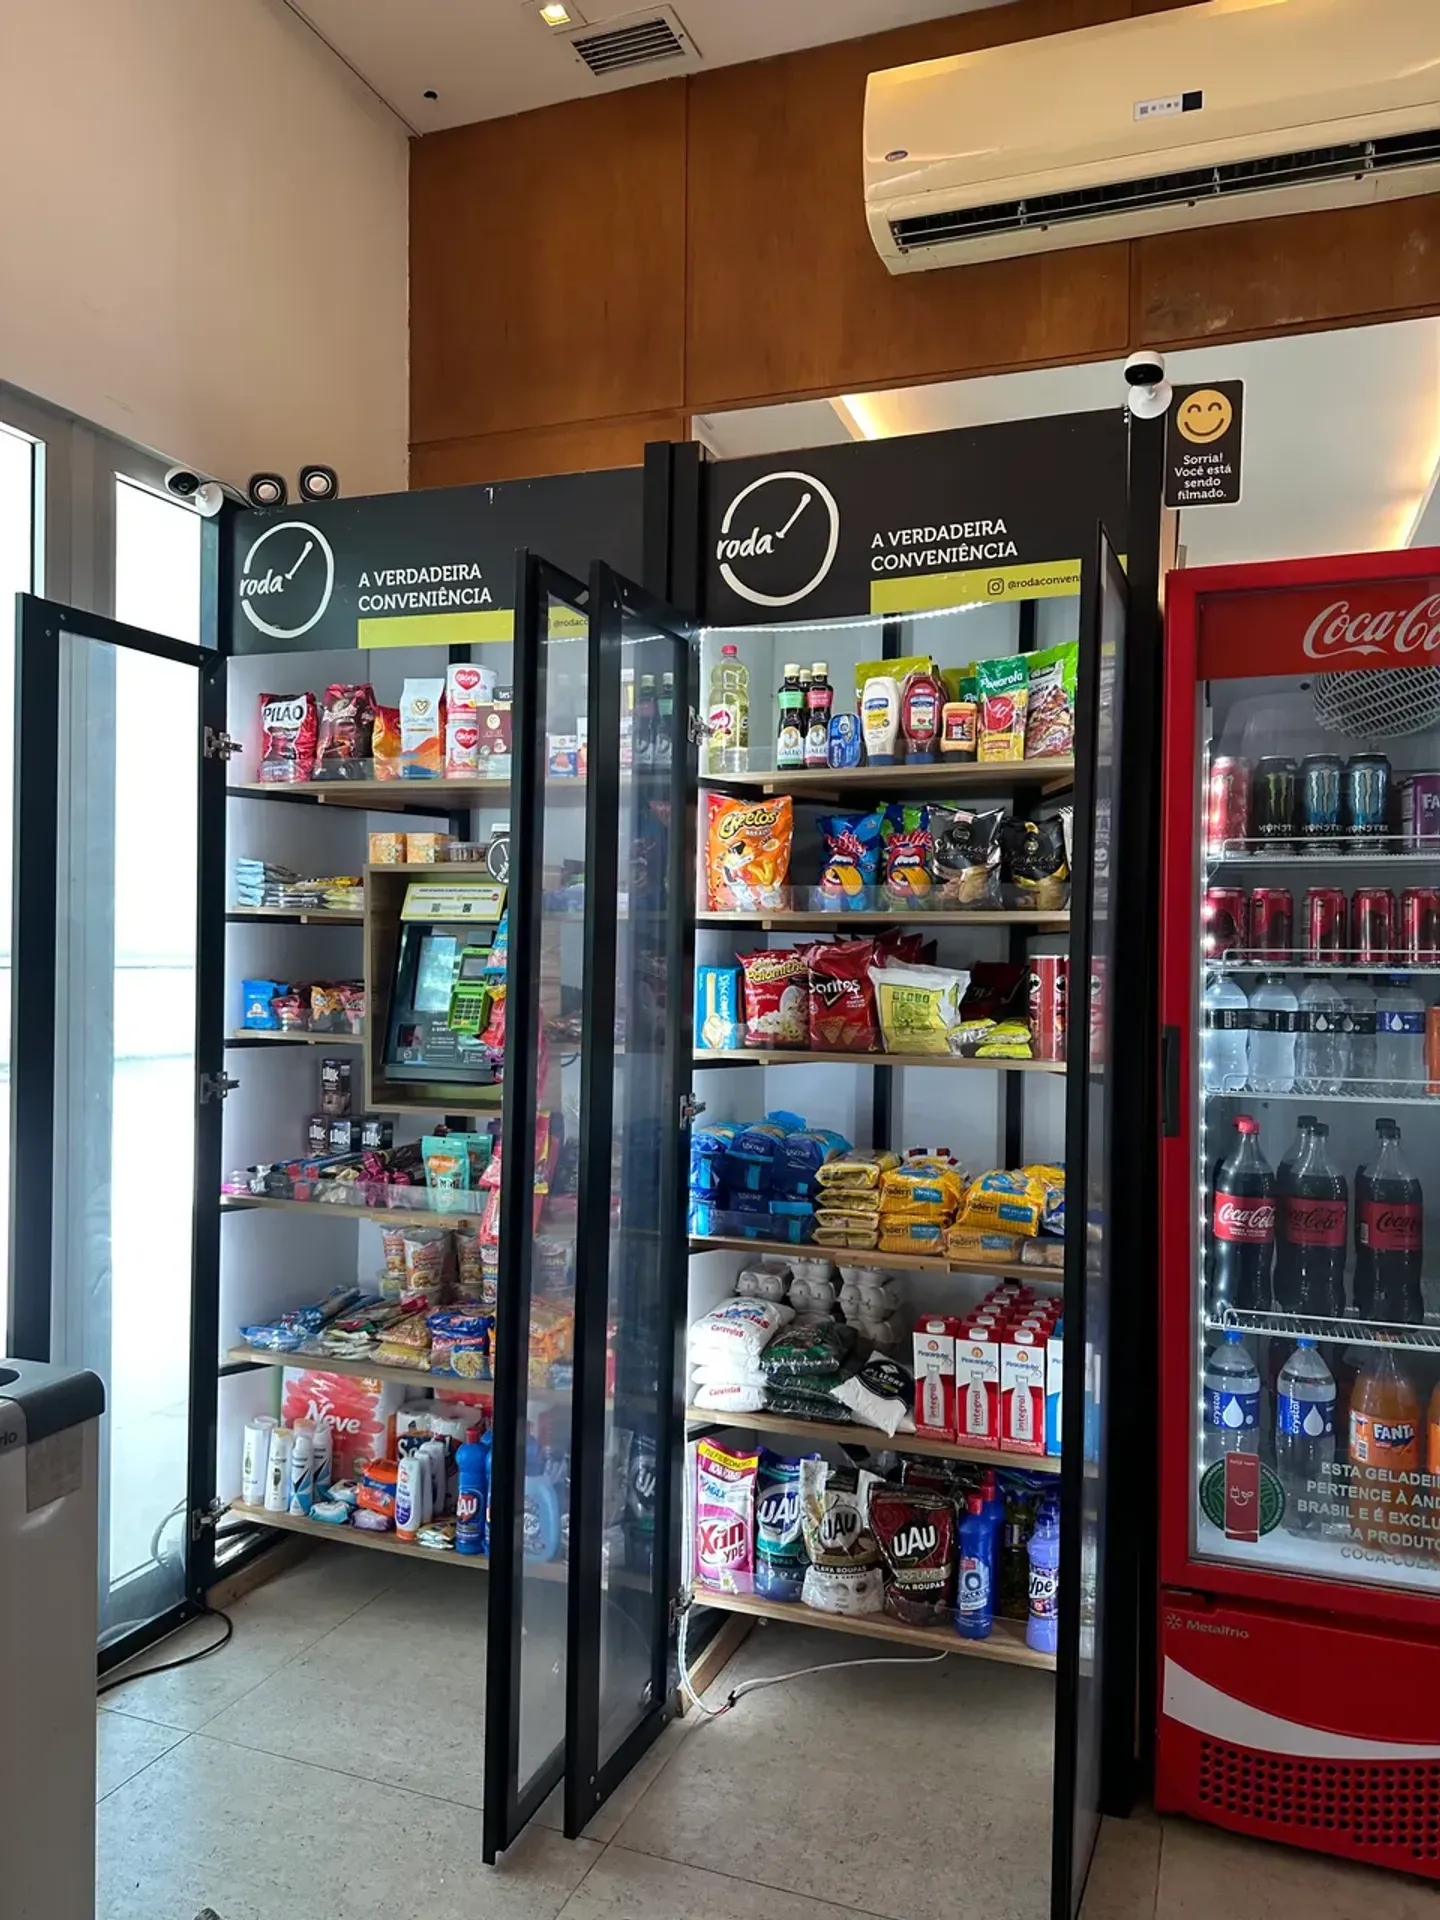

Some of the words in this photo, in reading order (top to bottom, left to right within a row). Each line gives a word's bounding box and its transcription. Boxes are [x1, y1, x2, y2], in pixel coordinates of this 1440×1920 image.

[1174, 464, 1204, 477] Você
[1206, 463, 1232, 475] está
[1183, 452, 1223, 465] Sorria!
[1177, 488, 1227, 500] filmado.
[1184, 476, 1221, 488] sendo
[716, 527, 774, 561] roda
[871, 532, 884, 549] A
[888, 518, 1007, 548] VERDADEIRA
[870, 541, 1018, 572] CONVENIÊNCIA
[239, 570, 285, 597] roda
[358, 571, 370, 588] A
[374, 562, 482, 587] VERDADEIRA
[358, 587, 492, 612] CONVENIÊNCIA
[263, 704, 304, 722] PILÃO
[719, 809, 779, 840] Cheetos
[304, 1399, 361, 1434] Neve
[973, 1390, 981, 1426] integral
[1017, 1395, 1026, 1432] integral
[1292, 1400, 1302, 1434] crystal
[1321, 1462, 1361, 1478] ESTA
[1306, 1480, 1391, 1503] PERTENCE
[1396, 1490, 1411, 1506] À
[759, 1494, 801, 1525] UAU
[1298, 1499, 1354, 1518] BRASIL
[1359, 1508, 1368, 1520] E
[1374, 1506, 1384, 1521] É
[893, 1525, 936, 1557] UAU
[912, 1581, 945, 1591] ROUPAS
[1187, 1619, 1249, 1639] Metalfrio
